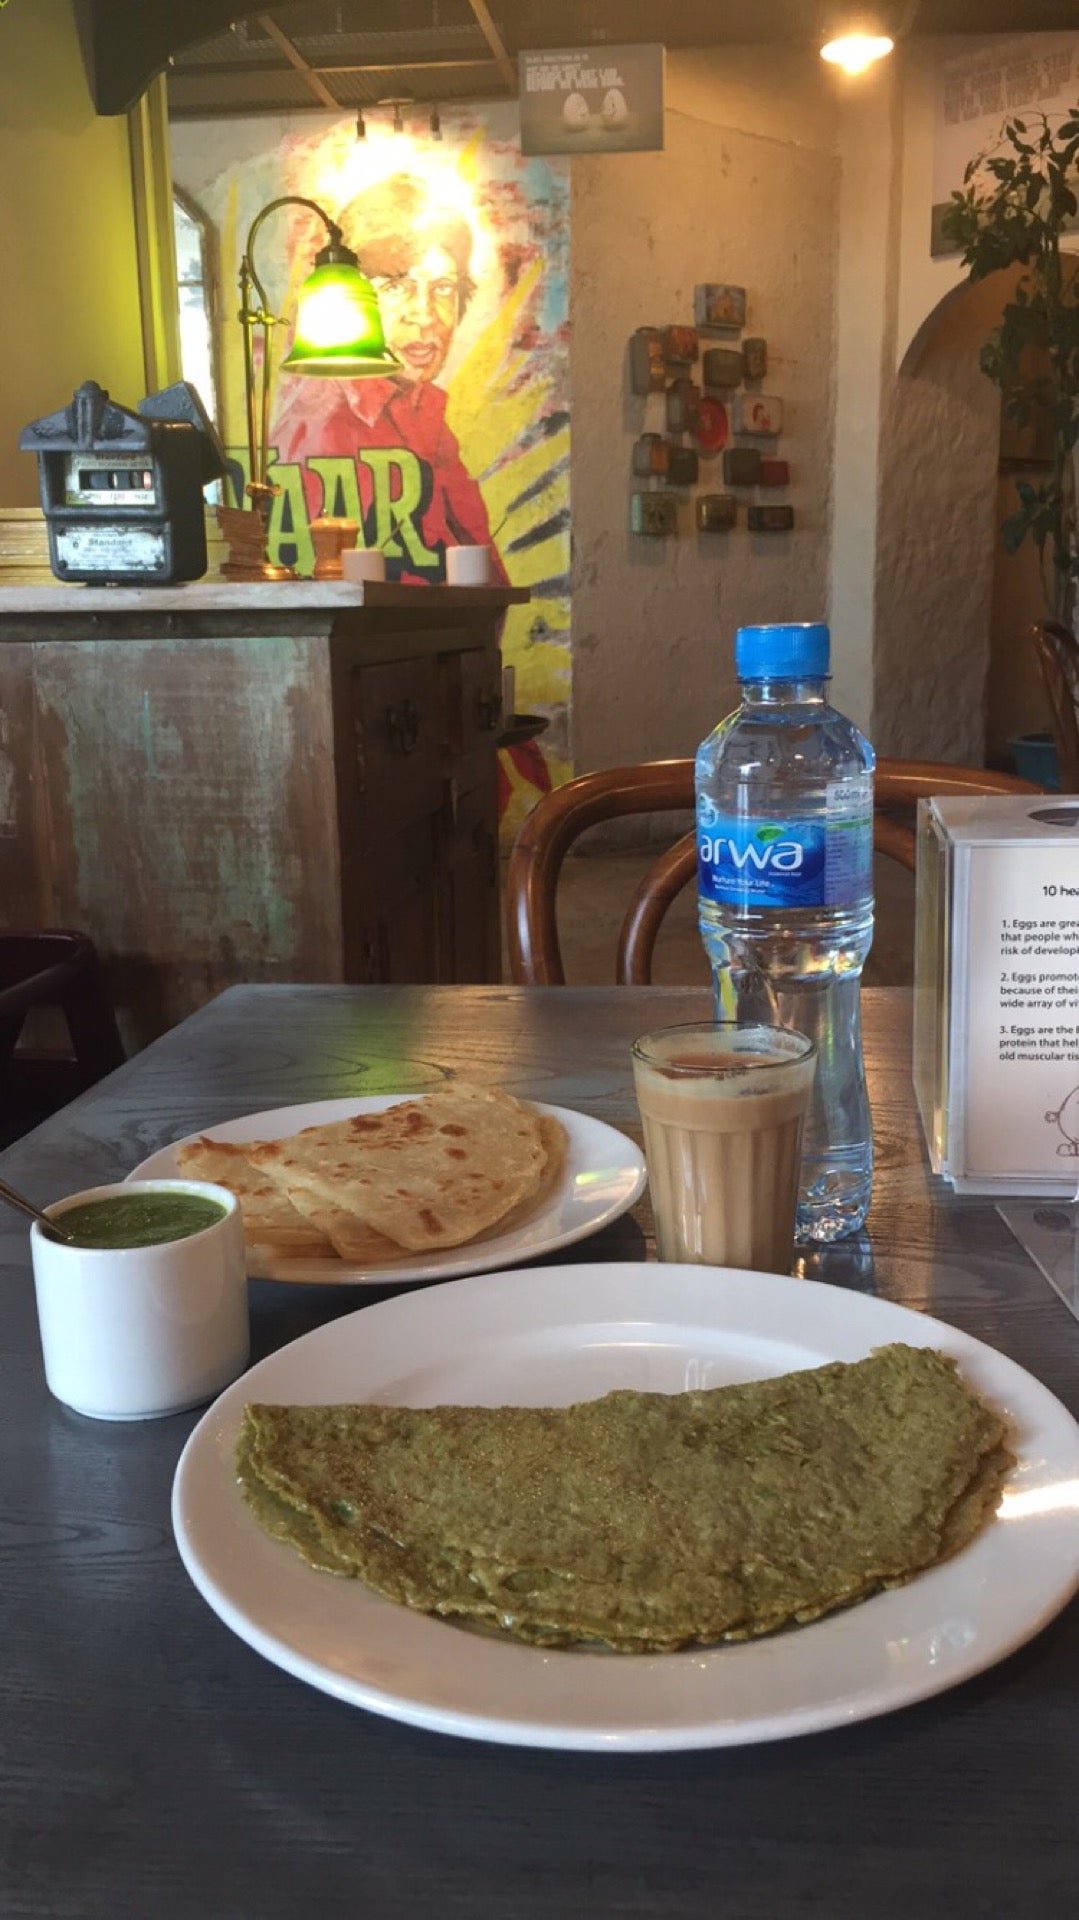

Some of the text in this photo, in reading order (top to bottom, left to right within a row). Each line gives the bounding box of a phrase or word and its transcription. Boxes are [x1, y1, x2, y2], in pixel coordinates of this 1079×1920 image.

[700, 835, 804, 870] arwa
[1042, 885, 1057, 897] 10
[1002, 919, 1011, 928] 1.
[1012, 919, 1038, 931] Eggs
[1039, 920, 1056, 928] are
[1000, 932, 1022, 942] that
[1024, 931, 1060, 944] people
[1000, 946, 1019, 955] risk
[1020, 946, 1033, 955] of
[1000, 972, 1079, 984] 2. Eggs promot
[1000, 986, 1042, 995] because
[1044, 985, 1055, 995] of
[999, 999, 1024, 1008] wide
[1027, 1001, 1053, 1010] array
[1055, 999, 1067, 1008] of
[999, 1025, 1009, 1034] 3.
[1011, 1025, 1035, 1036] Eggs
[1056, 1025, 1074, 1034] the
[999, 1038, 1037, 1049] protein
[1039, 1038, 1061, 1047] that
[999, 1051, 1015, 1060] old
[1017, 1051, 1065, 1060] muscular
